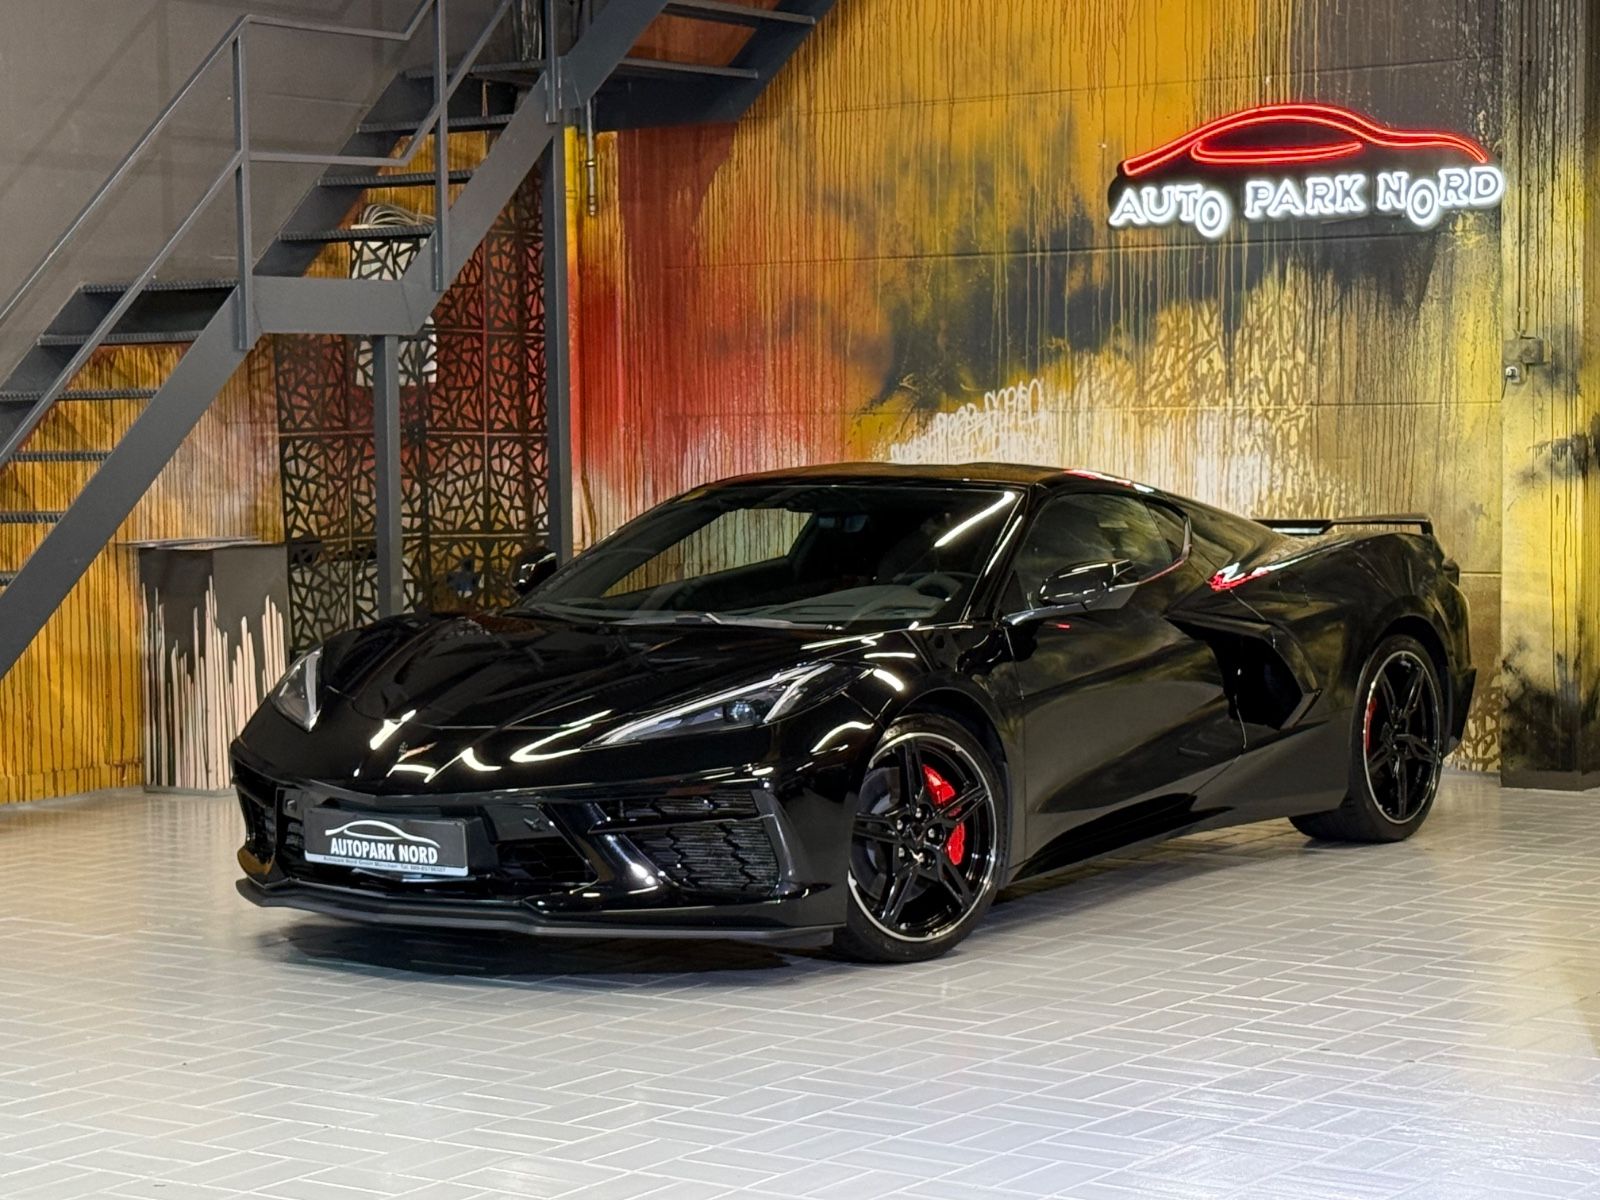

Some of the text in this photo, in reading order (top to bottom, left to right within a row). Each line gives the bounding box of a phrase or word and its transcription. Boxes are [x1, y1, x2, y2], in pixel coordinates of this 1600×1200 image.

[1109, 167, 1504, 238] AUTO PARK NORD
[330, 838, 438, 865] AUTOPARK NORD
